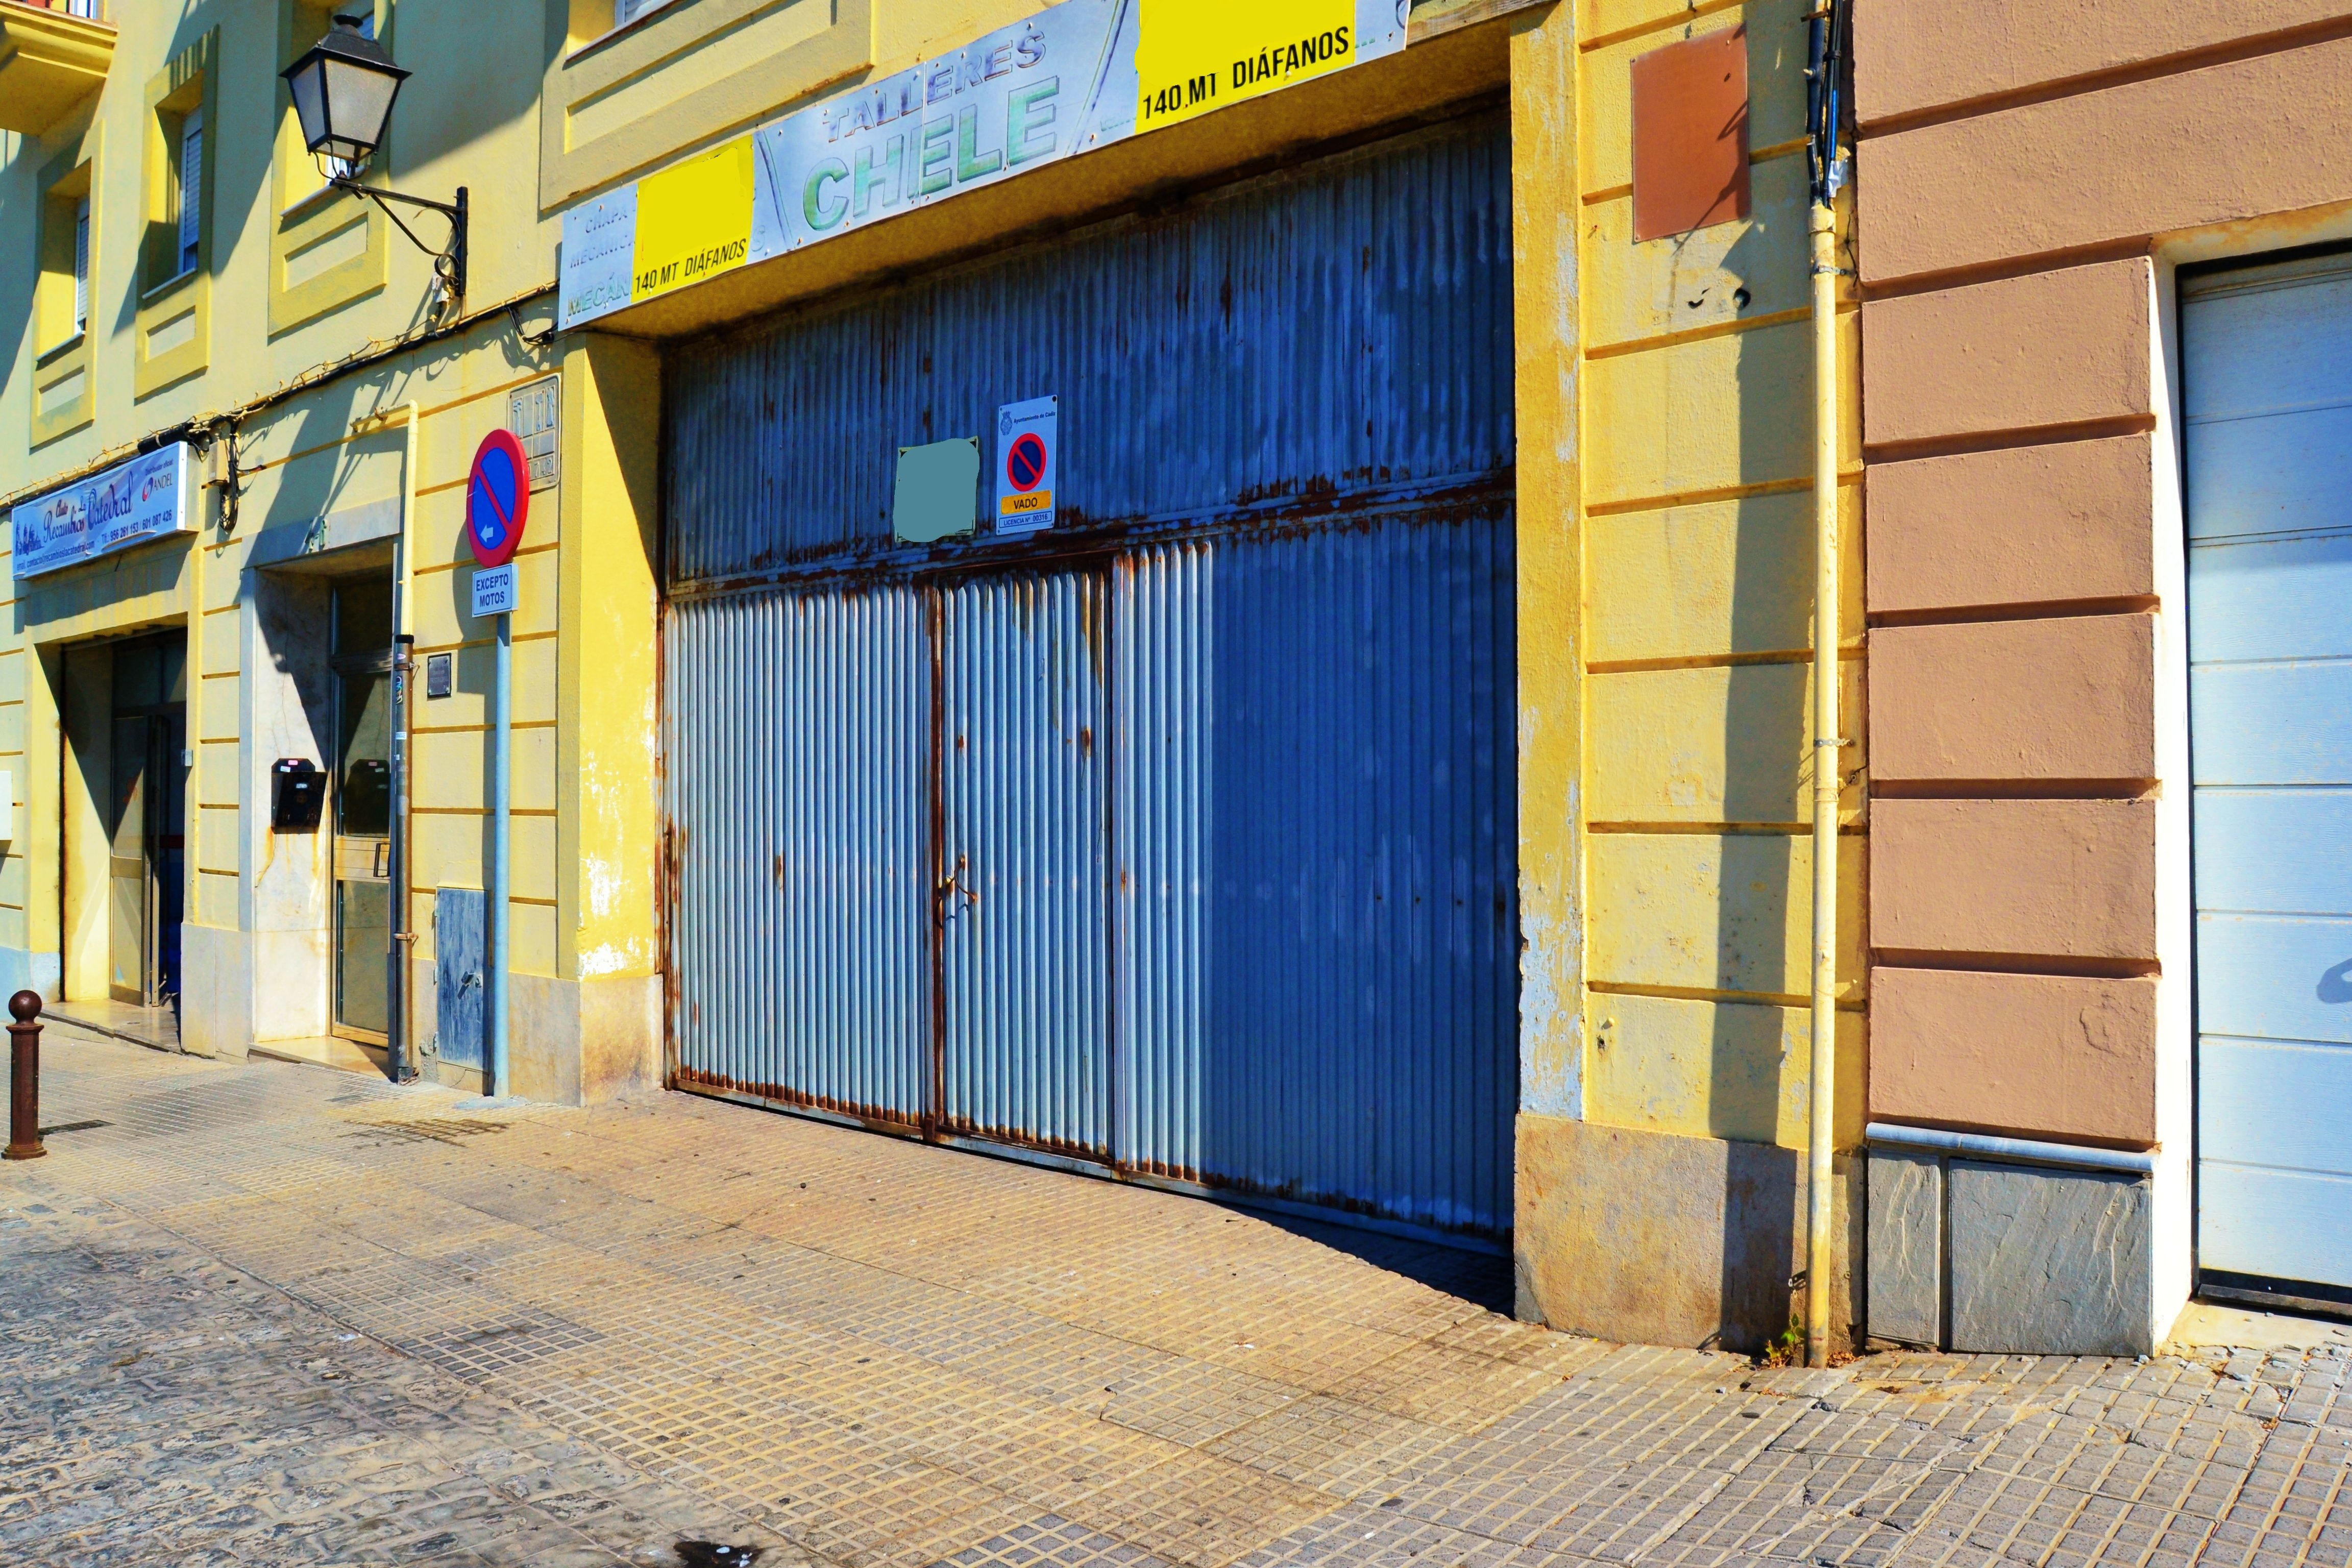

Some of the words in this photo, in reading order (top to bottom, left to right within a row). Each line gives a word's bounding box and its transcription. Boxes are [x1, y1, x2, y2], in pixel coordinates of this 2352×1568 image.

[1143, 84, 1181, 119] 140
[1233, 26, 1349, 89] DIÁFANOS
[822, 31, 1046, 143] TALLERES
[803, 75, 1060, 231] CHELE
[635, 270, 657, 293] 140
[660, 261, 679, 285] MT
[684, 238, 746, 277] DIÁFANOS
[1014, 415, 1039, 424] Ayuntamiento
[154, 473, 173, 491] ANDEL
[44, 505, 84, 543] Recambios
[87, 471, 133, 530] Catedral
[56, 499, 68, 518] Auto
[1013, 497, 1038, 509] VADO
[110, 529, 119, 541] 956
[120, 526, 128, 538] 261
[130, 522, 138, 534] 153
[142, 516, 151, 530] 601
[152, 513, 161, 527] 087
[163, 509, 172, 522] 426
[1033, 513, 1048, 522] 00316
[476, 573, 509, 592] EXCEPTO
[479, 591, 505, 607] MOTOS
